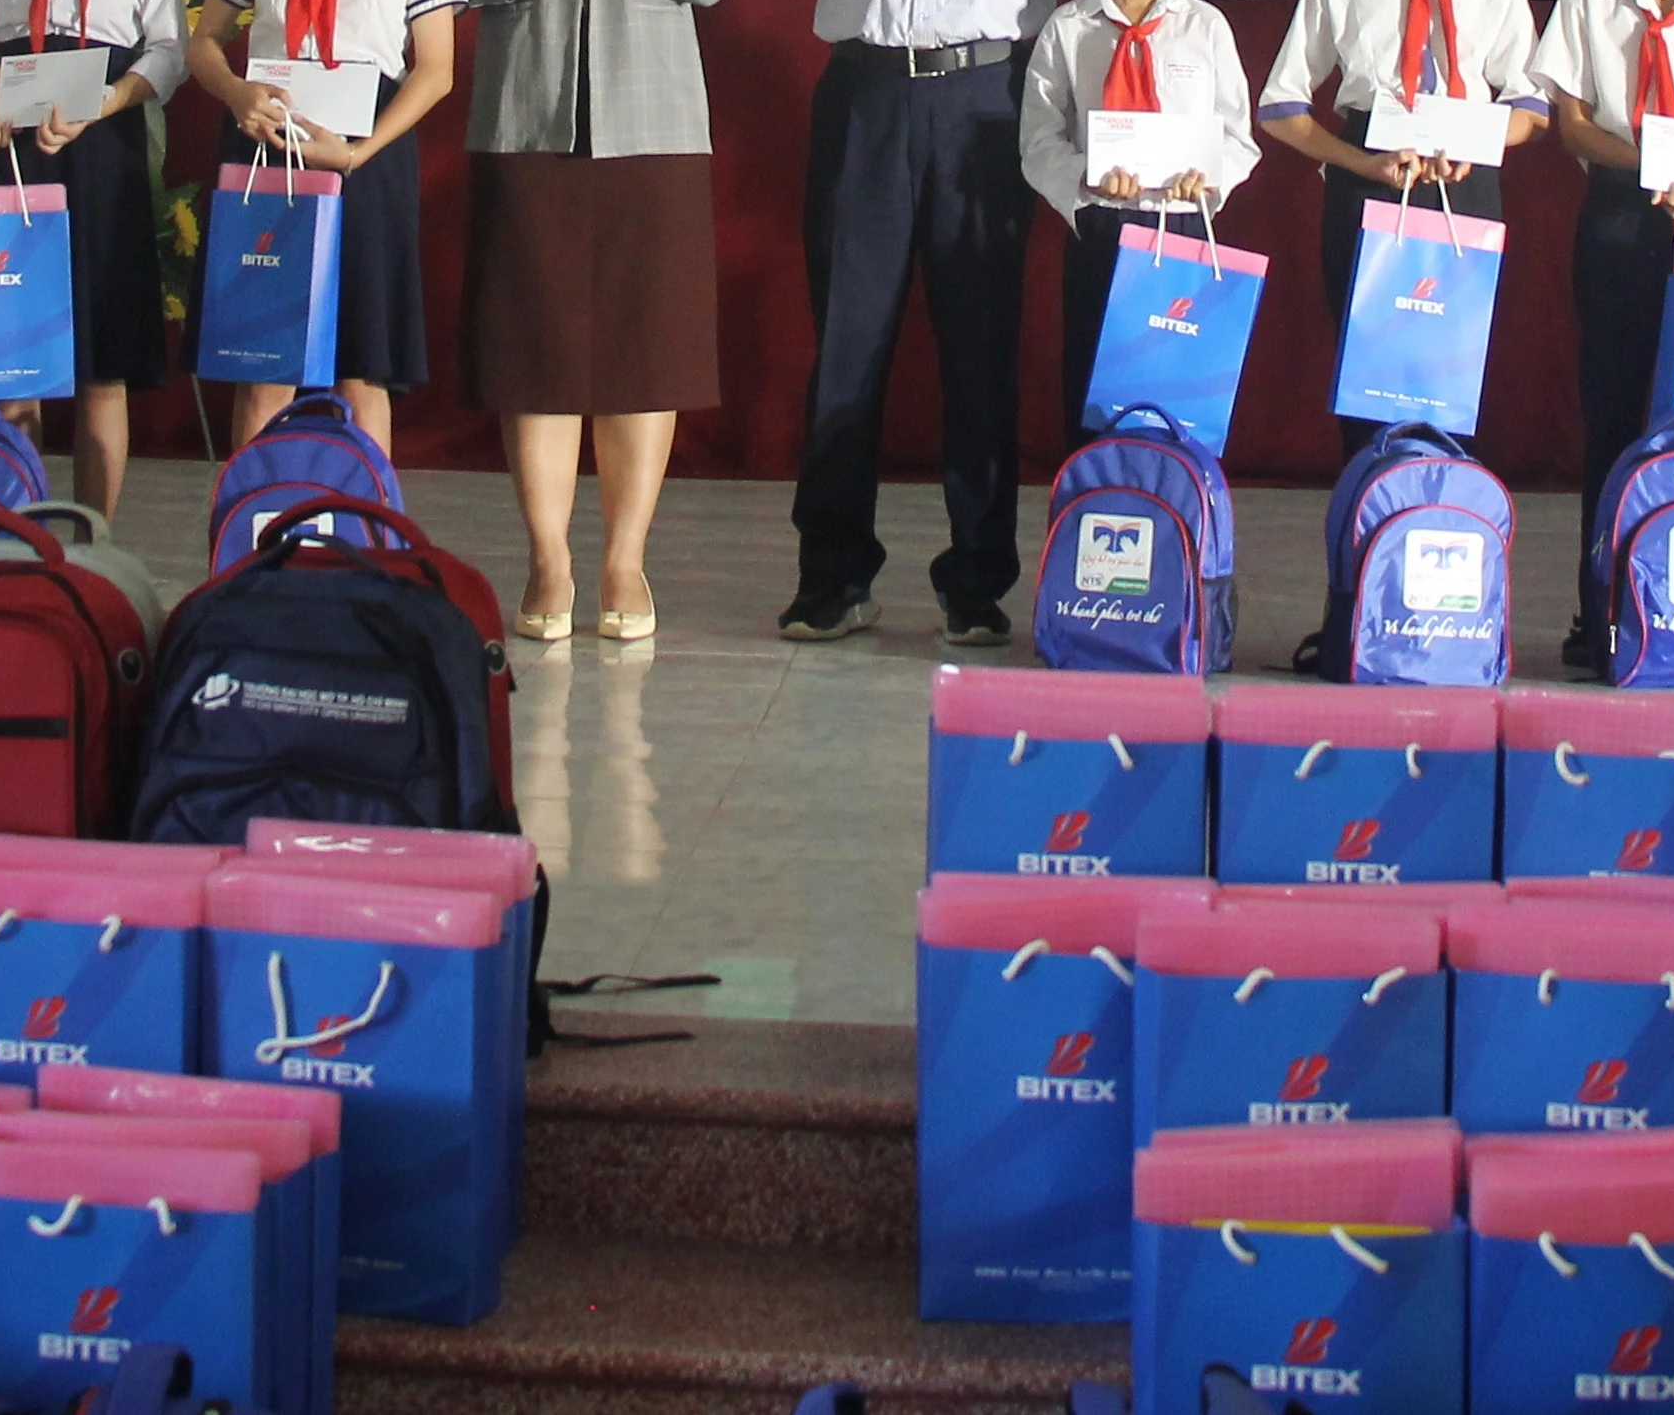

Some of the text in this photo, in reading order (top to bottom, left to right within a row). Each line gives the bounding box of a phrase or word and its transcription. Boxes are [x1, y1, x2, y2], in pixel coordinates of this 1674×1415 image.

[242, 254, 280, 266] BITEX
[1395, 296, 1444, 316] BITEX
[1149, 316, 1199, 337] BITEX
[1017, 854, 1110, 876] BITEX
[1306, 862, 1399, 884] BITEX
[282, 1057, 374, 1087] BITEX
[1016, 1076, 1115, 1103] BITEX
[1249, 1103, 1351, 1125] BITEX
[1546, 1104, 1649, 1130] BITEX
[39, 1334, 130, 1363] BITE
[1252, 1366, 1359, 1394] BITEX
